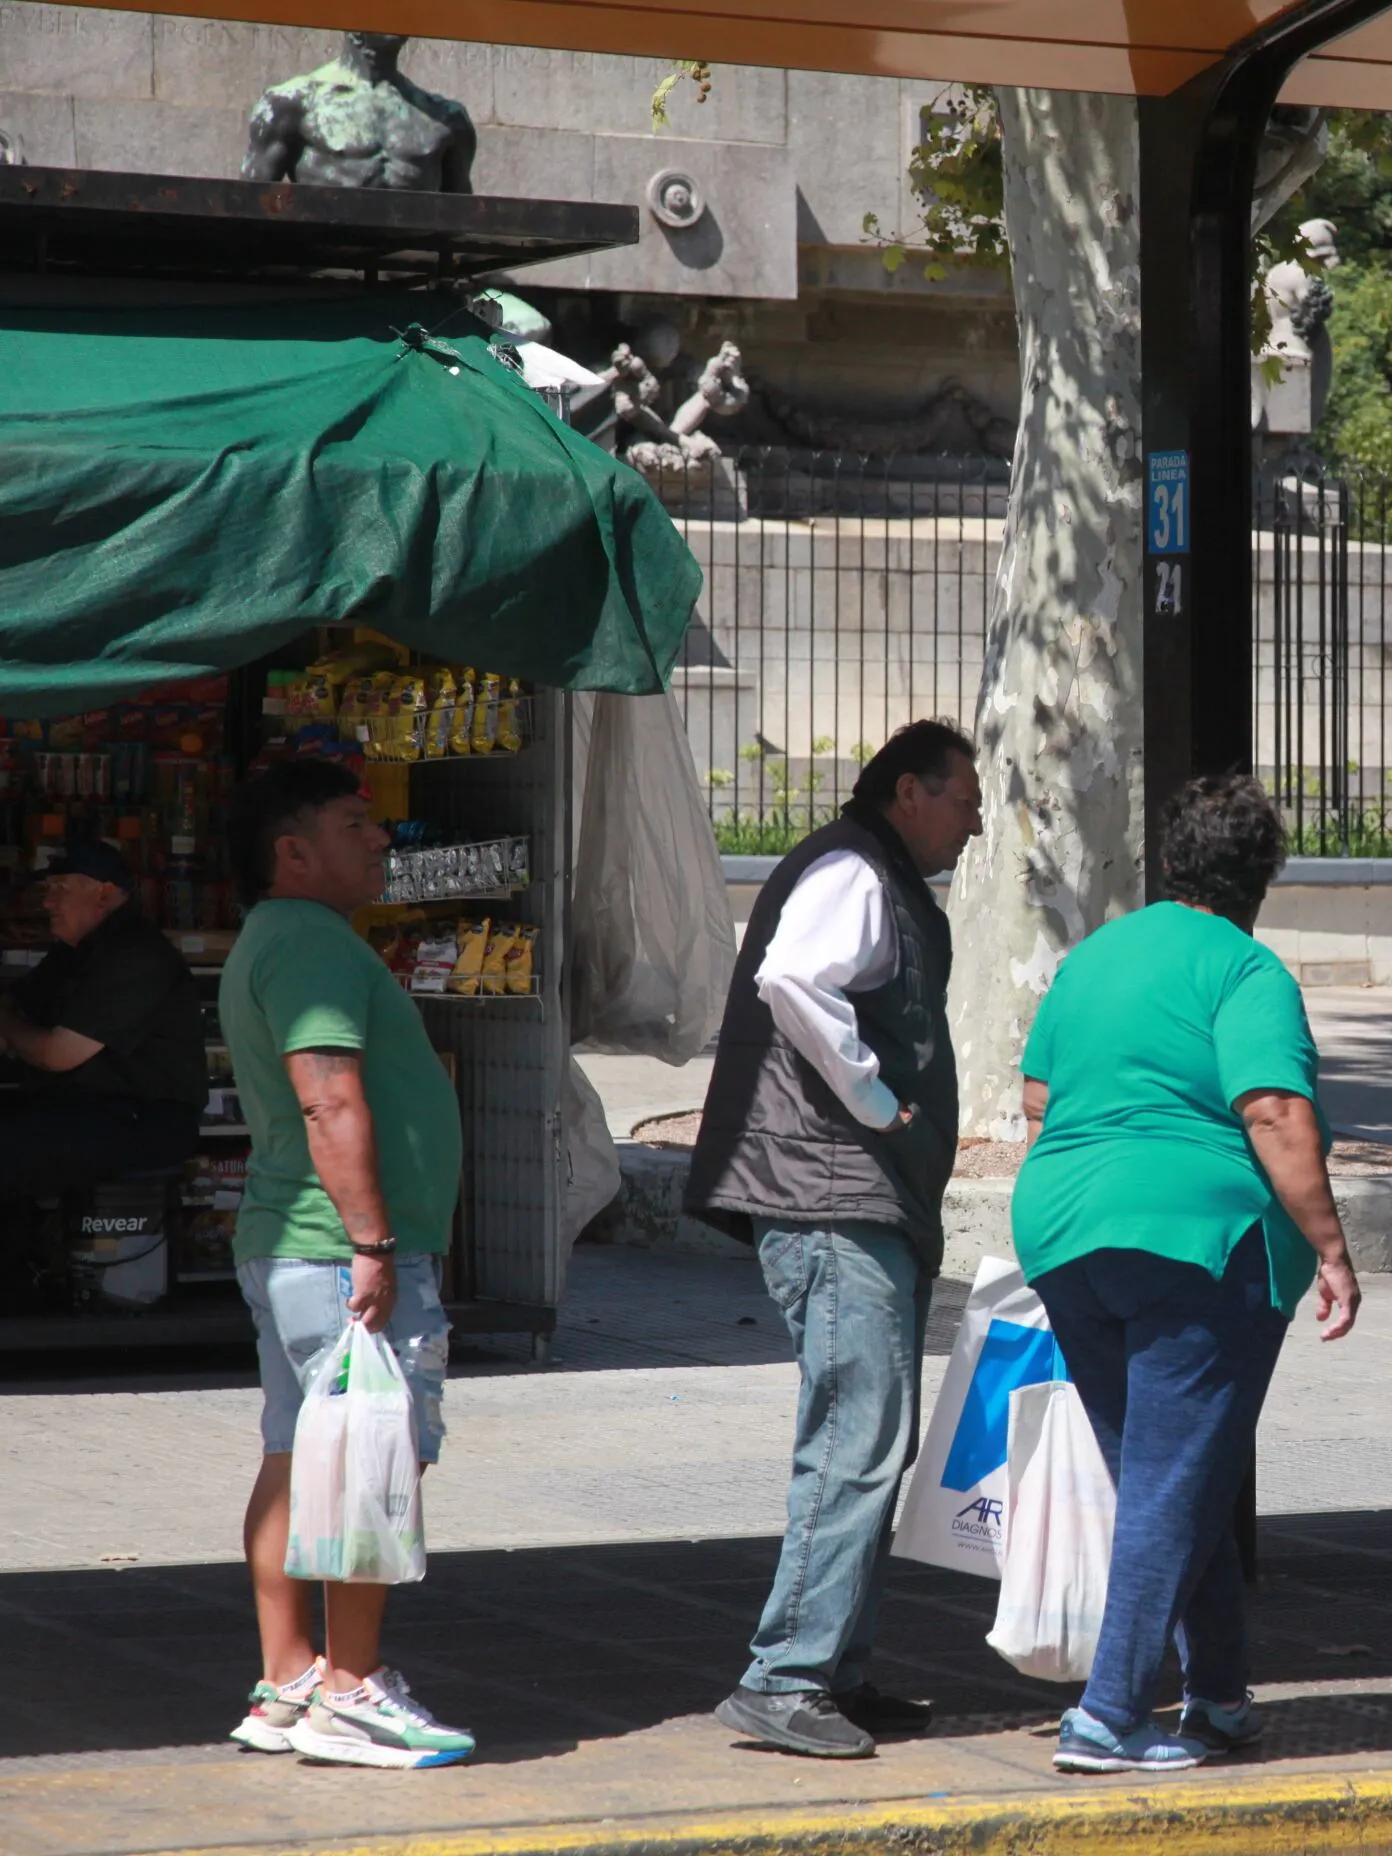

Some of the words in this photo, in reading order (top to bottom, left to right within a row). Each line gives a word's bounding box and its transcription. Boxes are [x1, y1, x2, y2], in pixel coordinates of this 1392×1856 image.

[1151, 456, 1186, 470] PARADA
[1151, 469, 1187, 482] LINEA
[1154, 482, 1185, 549] 31
[82, 1216, 148, 1233] Revear
